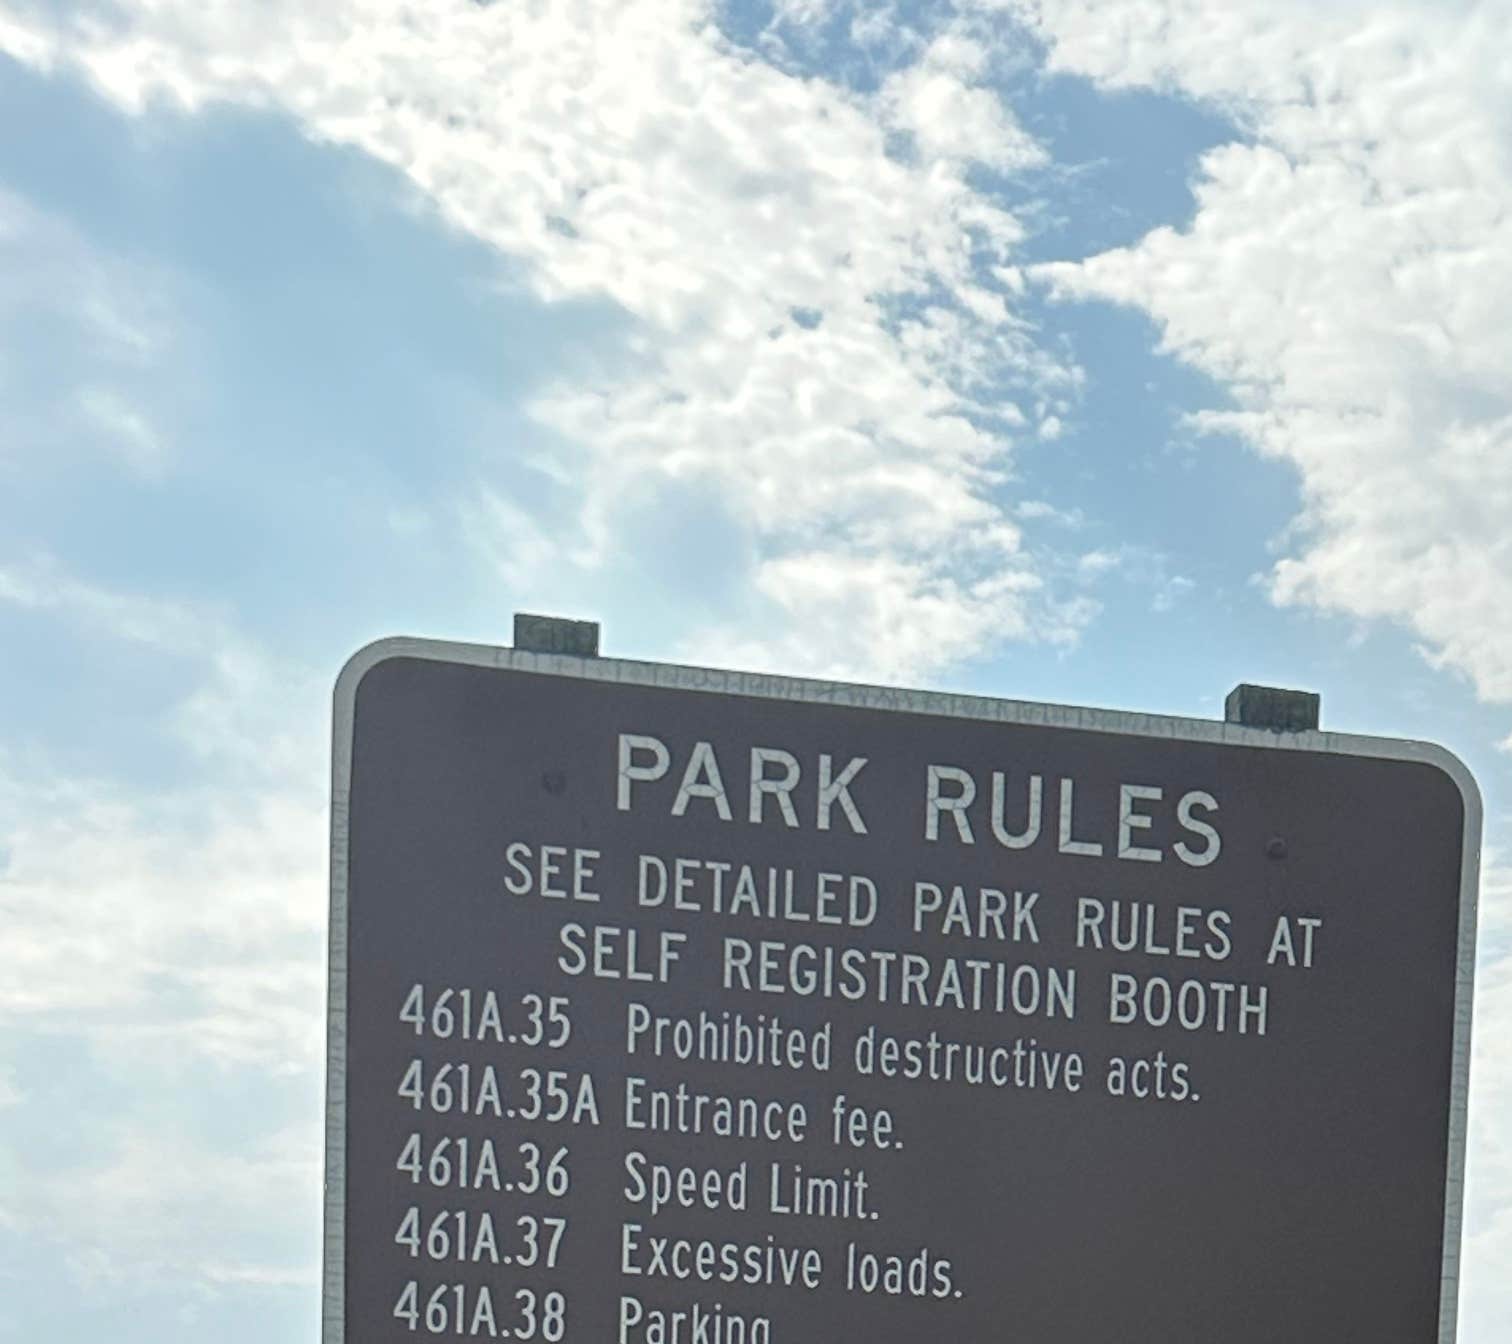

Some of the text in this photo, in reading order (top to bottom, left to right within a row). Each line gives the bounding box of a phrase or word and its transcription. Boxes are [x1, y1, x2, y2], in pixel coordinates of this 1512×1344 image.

[617, 733, 1221, 867] PARK RULES
[504, 842, 1322, 968] SEE DETAILED PARK RULES AT
[558, 923, 1268, 1036] SELF REGISTRATION BOOTH
[399, 983, 1200, 1101] 461A.35 Prohibited destructive acts.
[397, 1059, 903, 1149] 461A.35A Entrance fee.
[396, 1133, 879, 1220] 461A.36 Speed Limit.
[394, 1207, 963, 1298] 461A.37 Excessive loads.
[393, 1281, 565, 1342] 461A.38
